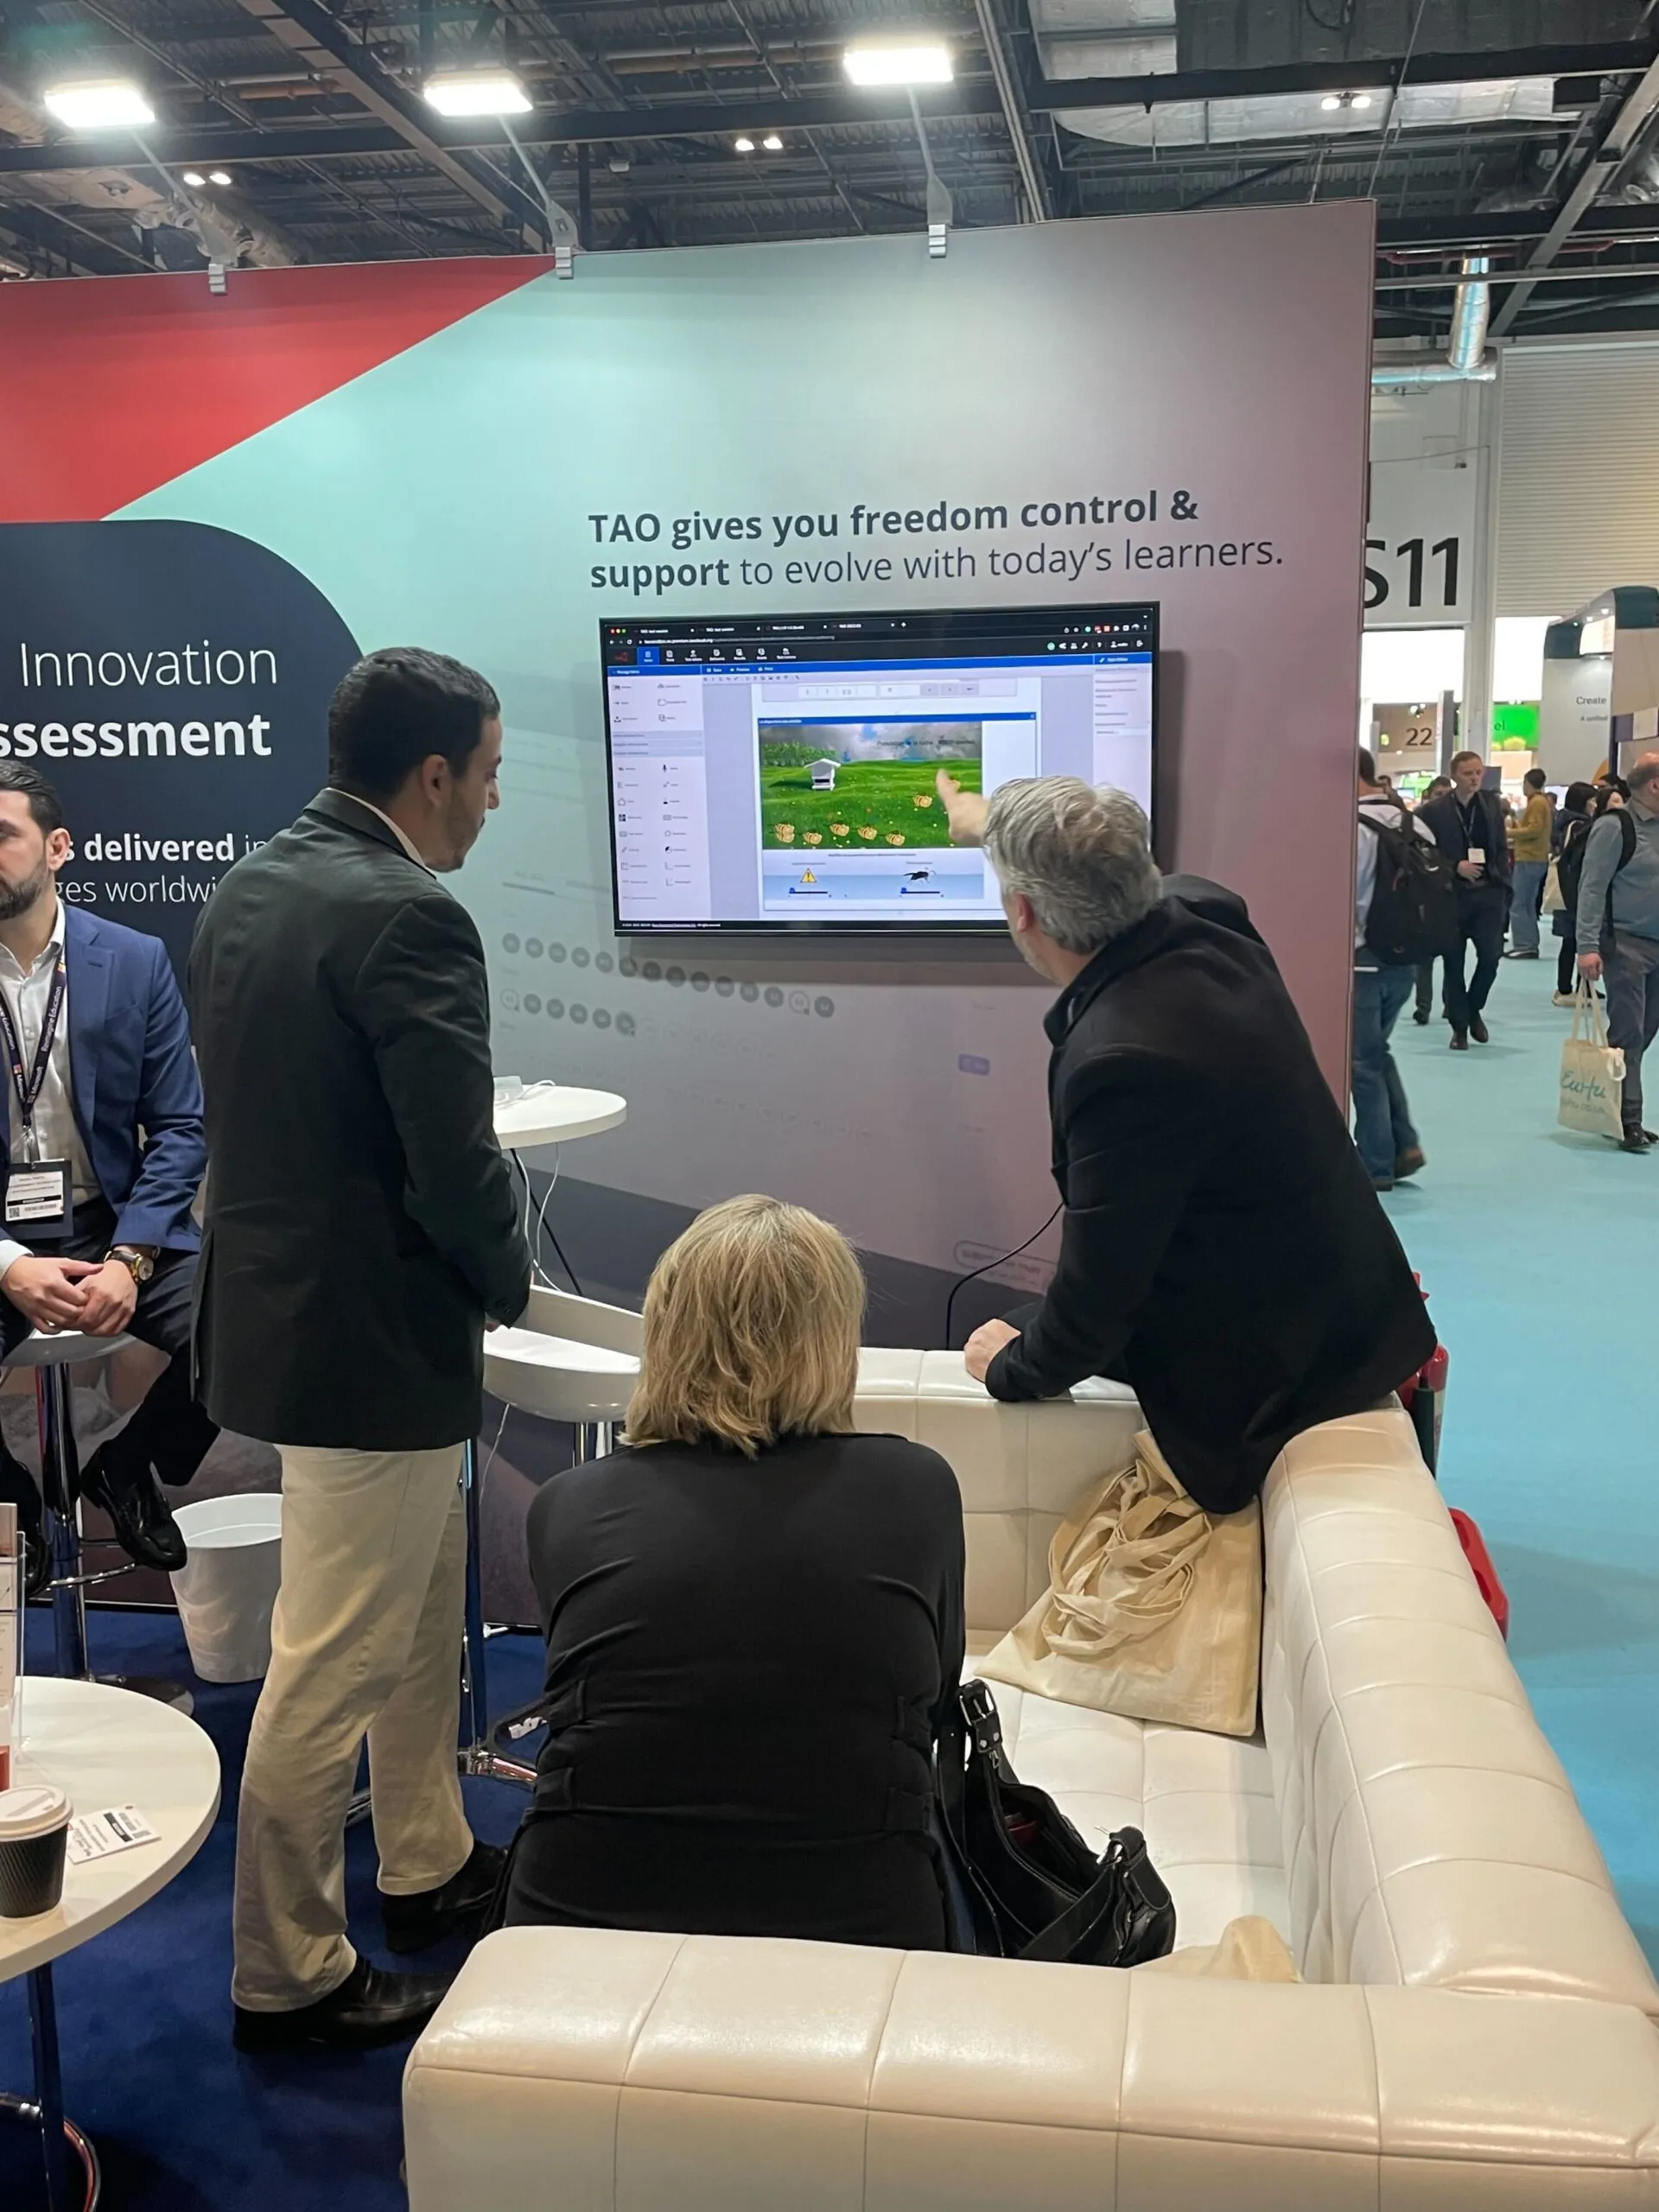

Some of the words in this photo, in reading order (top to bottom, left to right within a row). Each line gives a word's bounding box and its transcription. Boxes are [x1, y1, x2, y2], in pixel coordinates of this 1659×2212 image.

[588, 512, 660, 543] TAO
[671, 511, 762, 550] gives
[772, 513, 839, 548] you
[850, 501, 1008, 535] freedom
[1020, 490, 1157, 527] control
[1171, 490, 1198, 520] &
[590, 559, 730, 596] support
[741, 557, 773, 584] to
[785, 551, 892, 583] evolve
[903, 546, 976, 579] with
[1125, 538, 1283, 569] learners.
[1363, 537, 1459, 609] S11
[21, 639, 276, 686] Innovation
[1576, 696, 1607, 705] Create
[1406, 728, 1433, 747] 22
[84, 833, 234, 861] delivered
